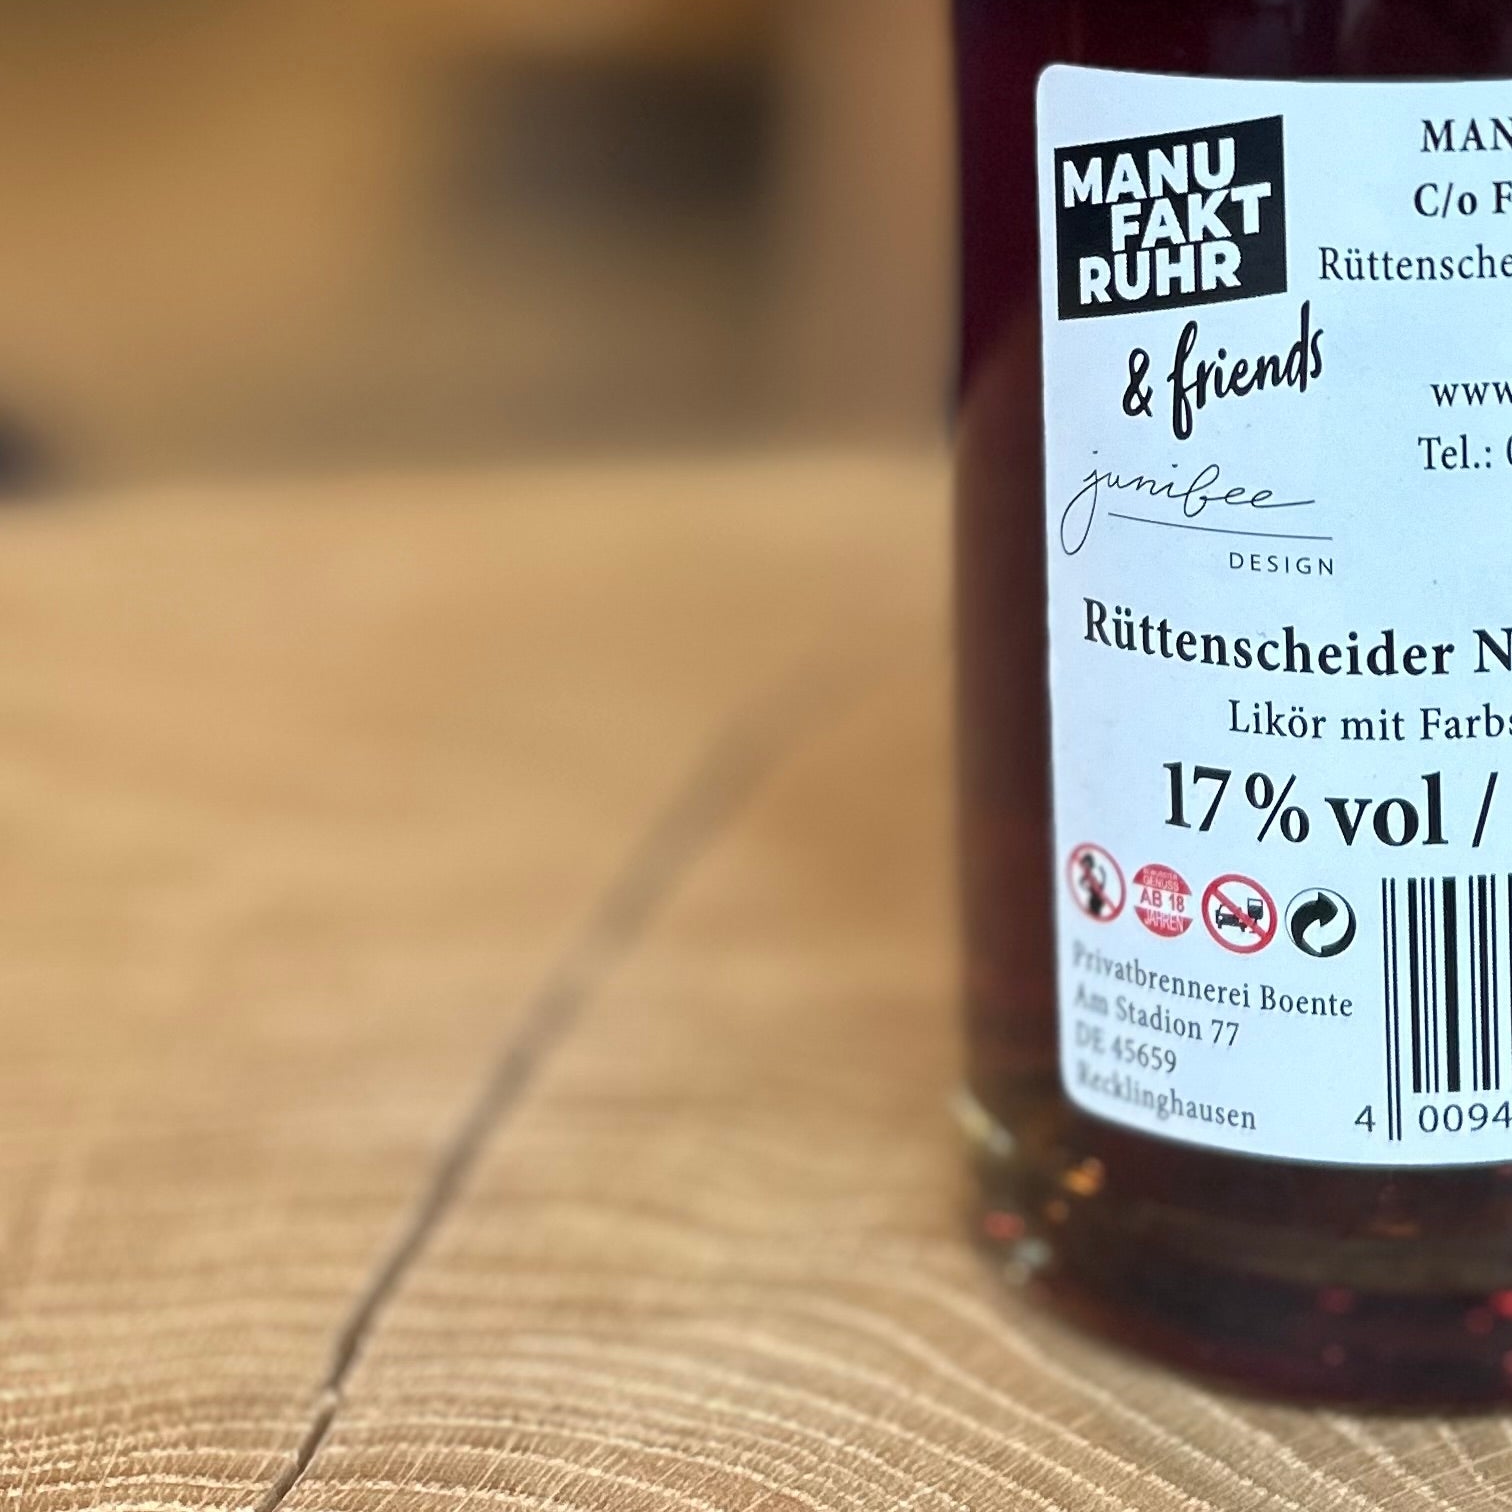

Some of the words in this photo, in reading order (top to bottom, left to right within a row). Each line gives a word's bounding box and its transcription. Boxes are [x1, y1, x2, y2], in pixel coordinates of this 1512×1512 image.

[1062, 136, 1237, 208] MANU
[1413, 181, 1479, 219] C/o
[1110, 181, 1272, 254] FAKT
[1079, 240, 1242, 306] RUHR
[1122, 347, 1153, 418] &
[1166, 299, 1324, 441] friends
[1417, 433, 1494, 471] Tel.:
[1060, 450, 1315, 556] junibee
[1228, 551, 1335, 577] DESIGN
[1083, 597, 1454, 676] Rüttenscheider
[1228, 698, 1327, 741] Likör
[1340, 706, 1406, 742] mit
[1324, 770, 1448, 846] vol
[1470, 771, 1498, 848] /
[1140, 887, 1163, 907] AB
[1168, 892, 1185, 912] 18
[1143, 909, 1184, 932] JAHREN
[1070, 938, 1251, 1008] Privatbrennerei
[1260, 984, 1354, 1017] Boente
[1073, 983, 1109, 1015] Am
[1115, 997, 1203, 1041] Stadion
[1211, 1019, 1240, 1046] 77
[1110, 1035, 1178, 1074] 45659
[1354, 1104, 1376, 1133] 4
